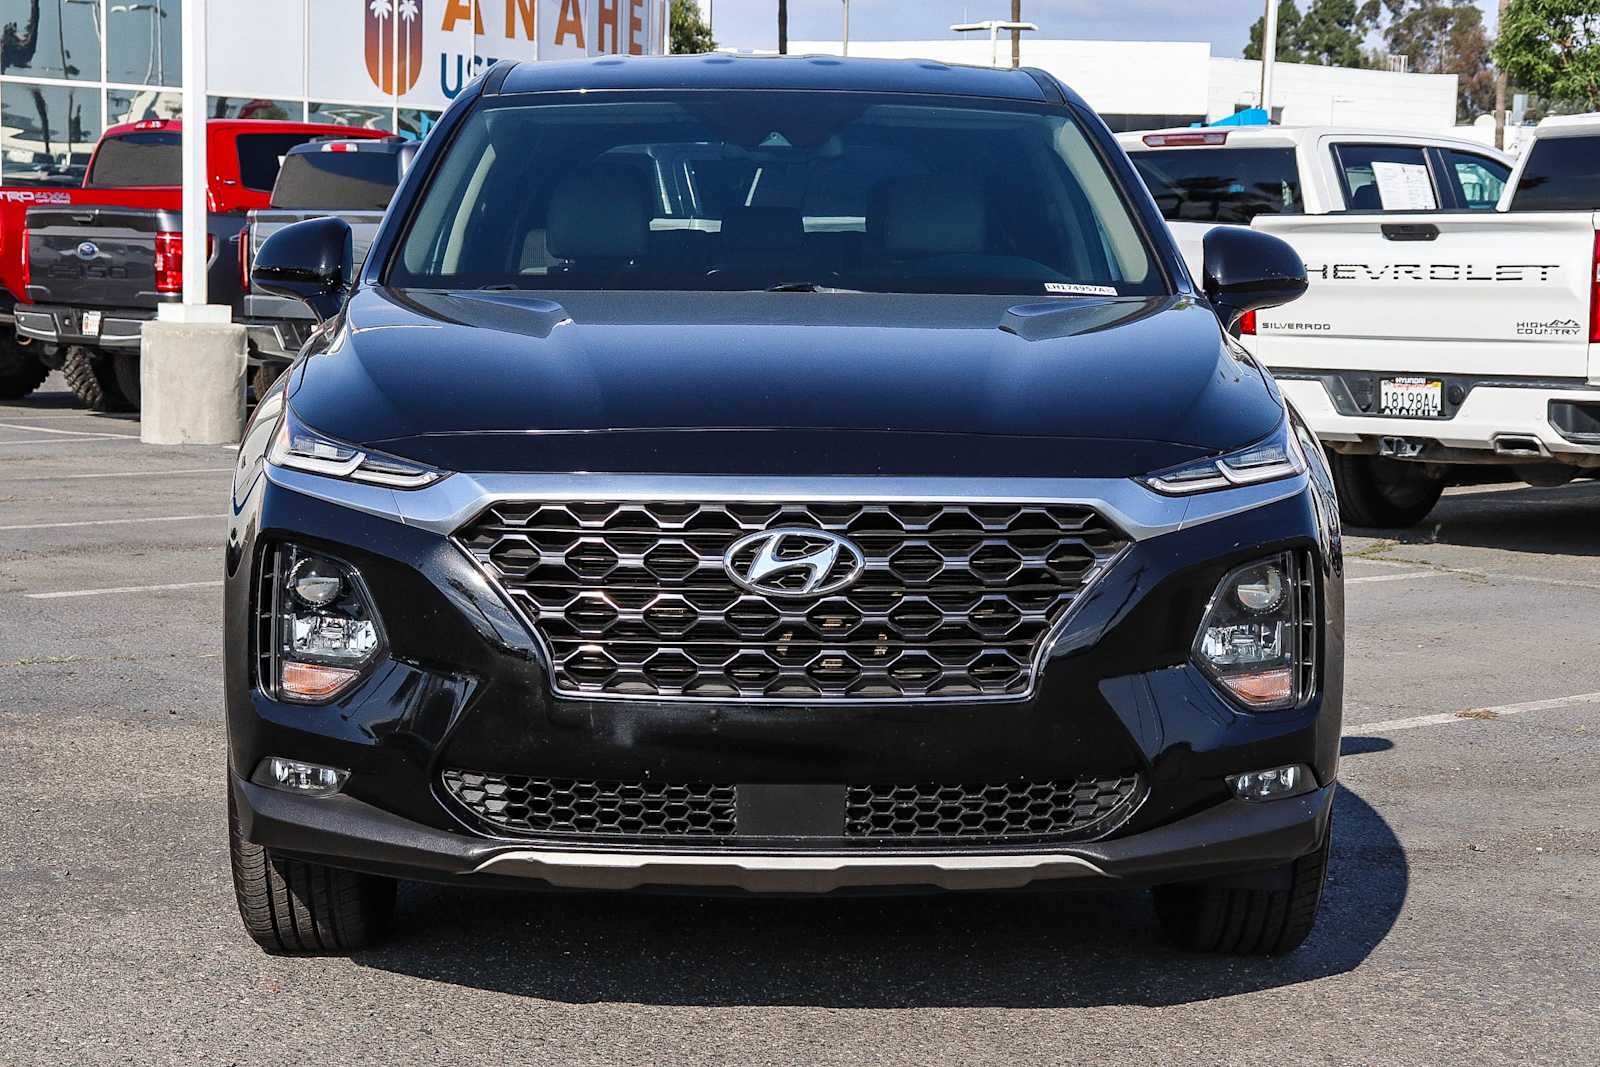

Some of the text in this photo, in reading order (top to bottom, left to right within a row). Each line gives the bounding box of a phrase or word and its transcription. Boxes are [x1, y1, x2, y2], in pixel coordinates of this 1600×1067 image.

[1304, 264, 1560, 281] HEVROLET
[1262, 322, 1331, 330] SILVERADO
[1384, 408, 1438, 417] ANAHEIM
